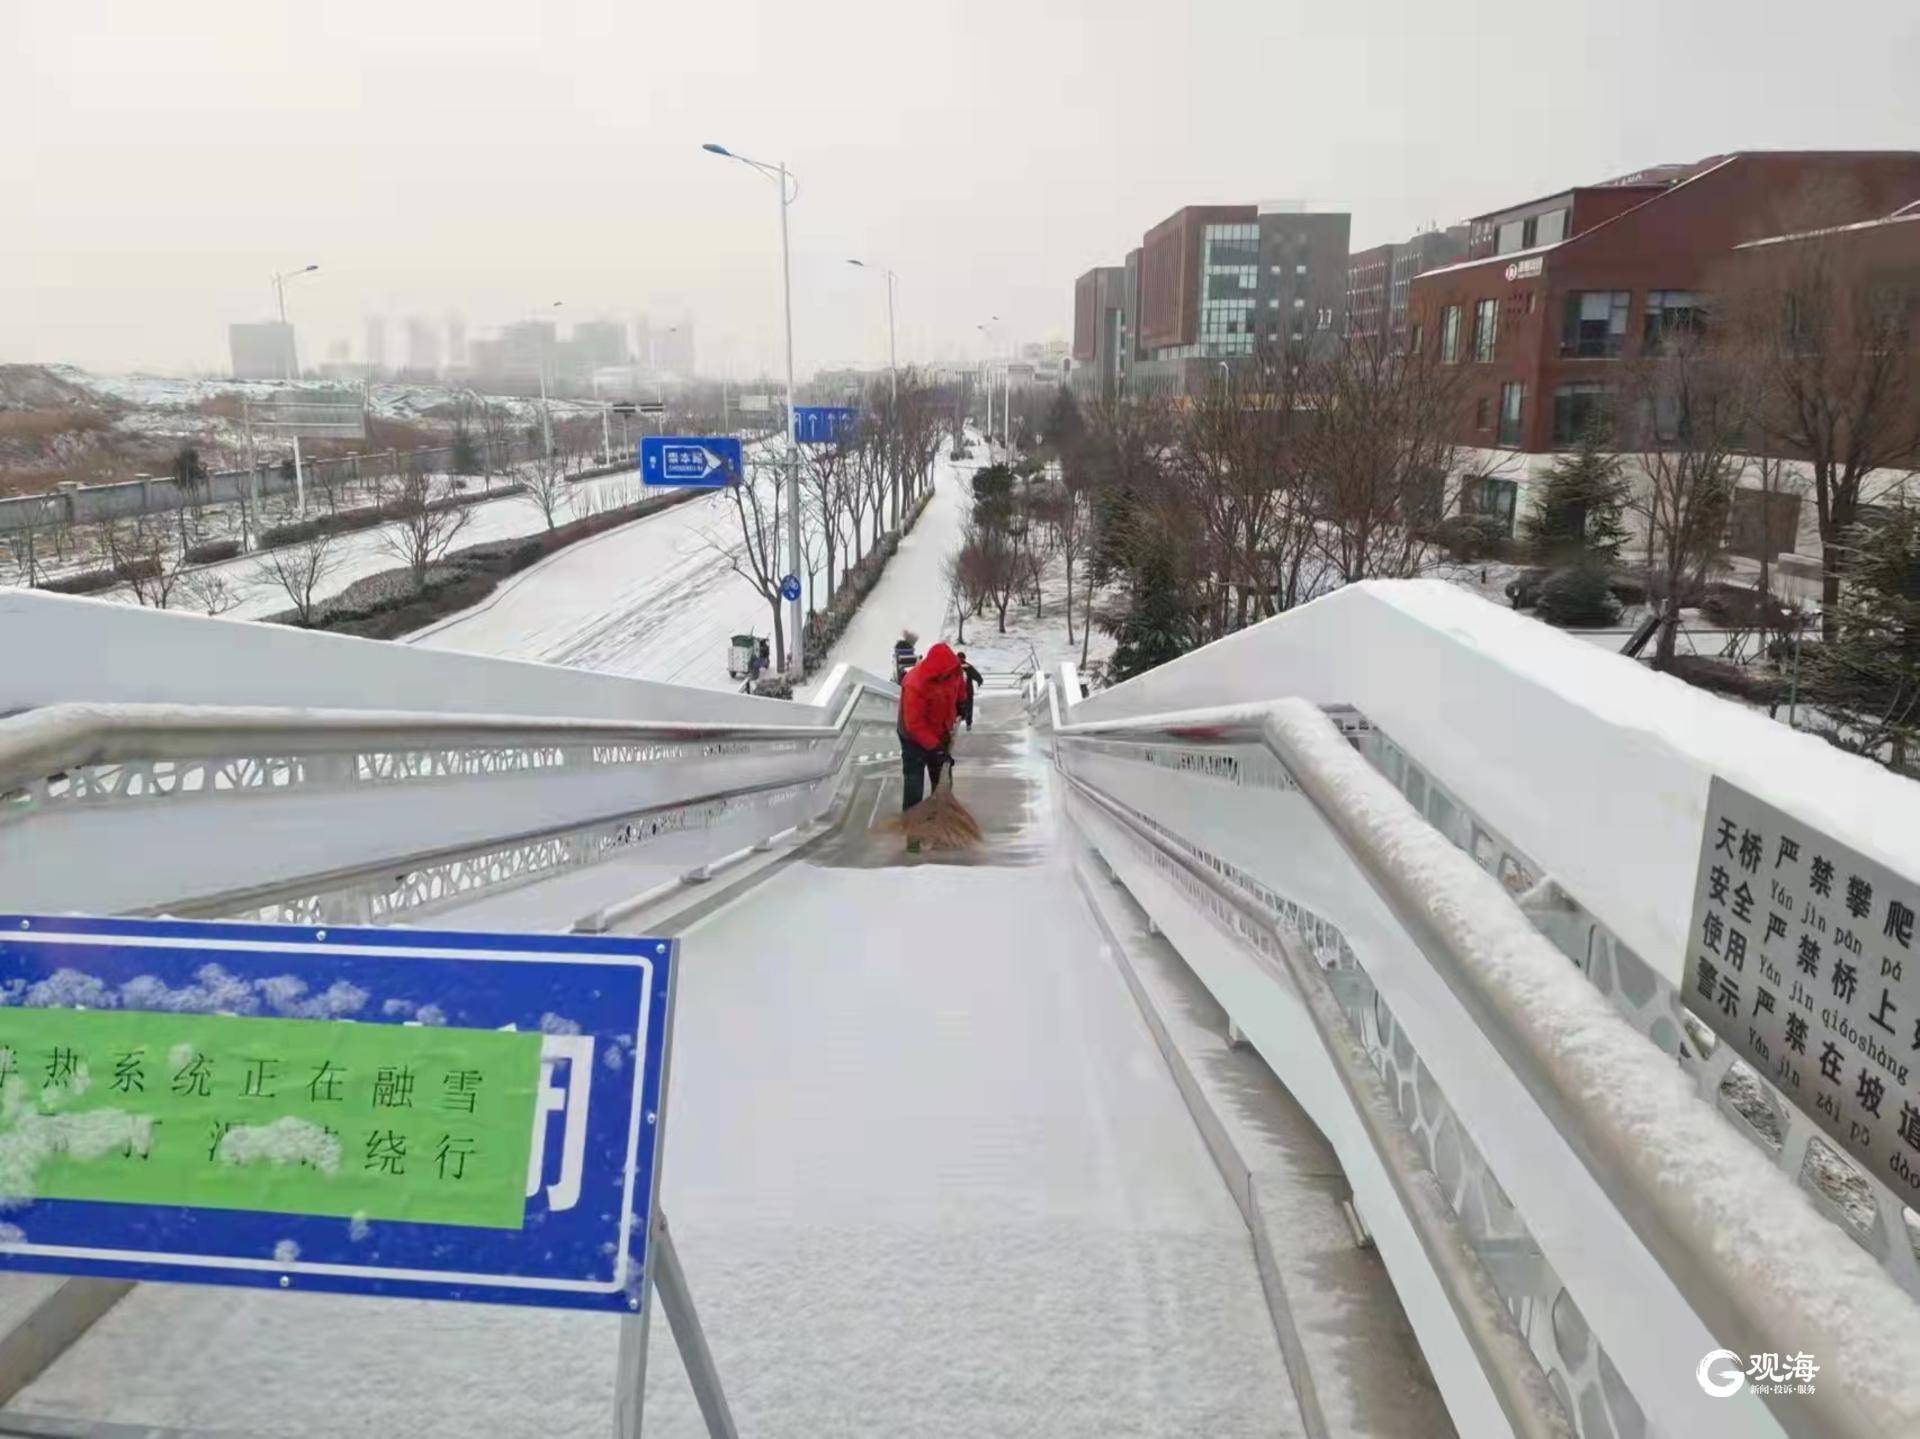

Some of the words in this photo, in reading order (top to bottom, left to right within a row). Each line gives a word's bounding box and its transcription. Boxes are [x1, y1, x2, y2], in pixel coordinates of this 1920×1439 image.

[1715, 816, 1763, 874] 天桥
[1709, 865, 1755, 924] 安全
[1774, 835, 1915, 950] 严禁攀爬
[1702, 910, 1748, 972] 使用
[1697, 956, 1740, 1017] 警示
